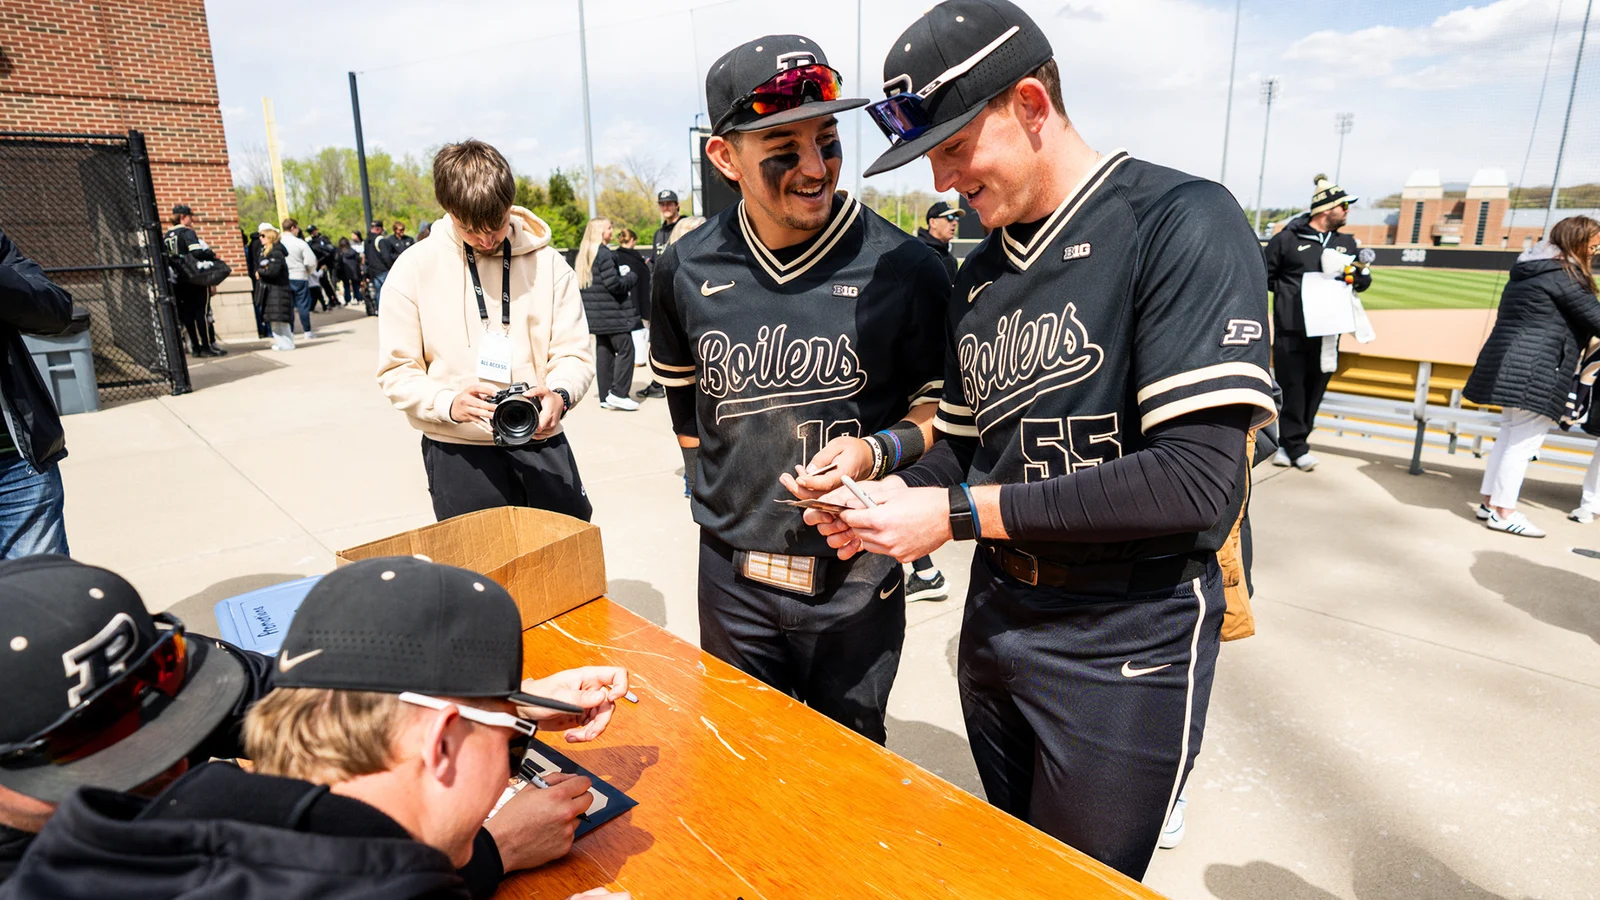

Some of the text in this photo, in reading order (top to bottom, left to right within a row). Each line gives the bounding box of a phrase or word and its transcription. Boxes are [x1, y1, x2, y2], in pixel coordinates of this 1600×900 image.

[698, 324, 868, 425] Boilers
[958, 302, 1105, 447] Boilers
[1222, 318, 1263, 346] P
[1020, 412, 1123, 484] 55
